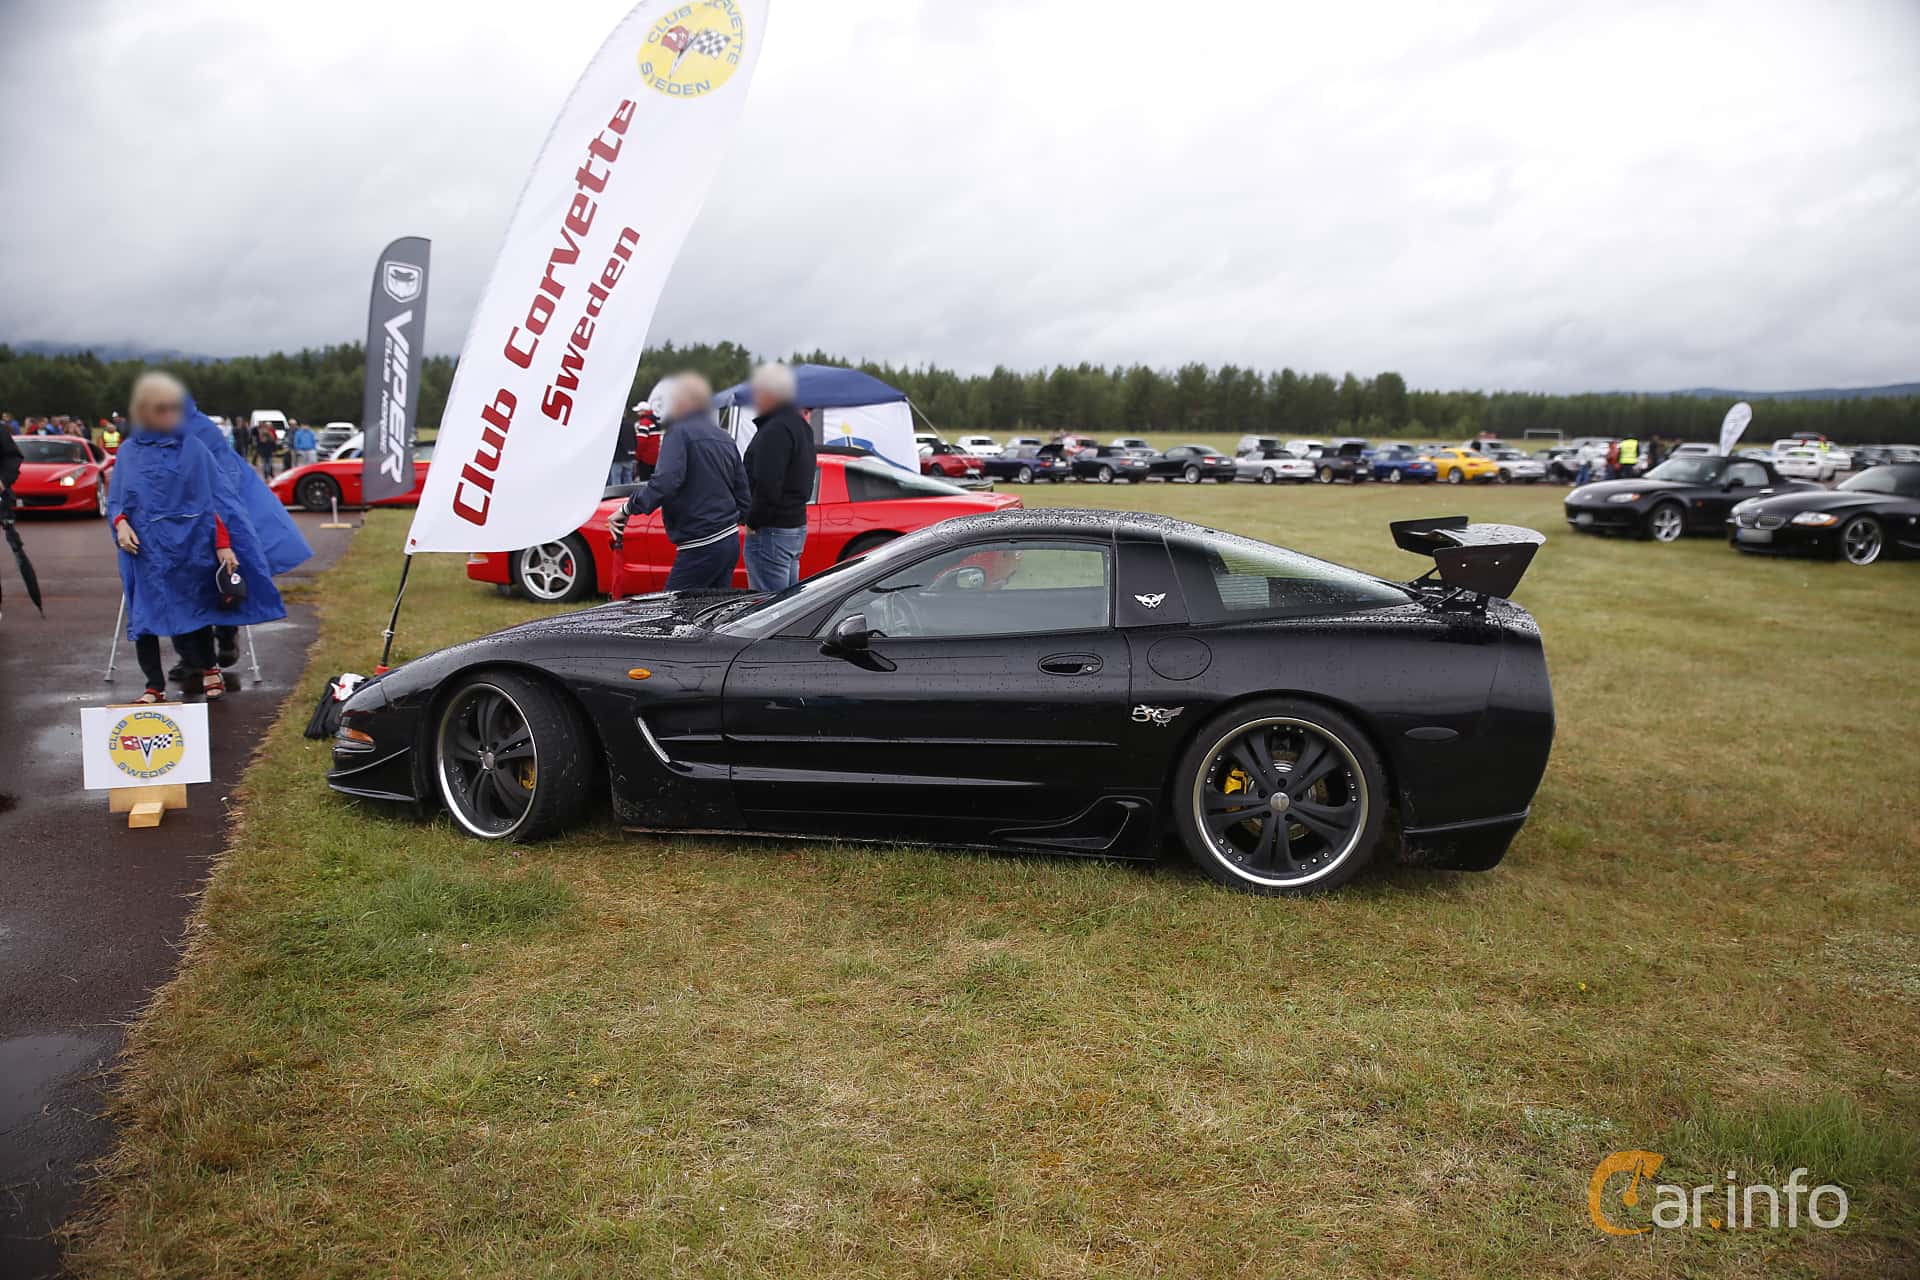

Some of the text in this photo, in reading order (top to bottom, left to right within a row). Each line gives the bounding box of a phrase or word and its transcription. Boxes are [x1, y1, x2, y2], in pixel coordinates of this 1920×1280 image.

[647, 0, 743, 65] CLUB RVETTE
[452, 98, 637, 527] Club Corvette
[540, 226, 641, 427] Sweden
[383, 336, 393, 383] CLUB
[380, 309, 413, 483] VIPER
[109, 711, 184, 751] CLUB CORVETTE
[118, 761, 176, 779] SWEDEN
